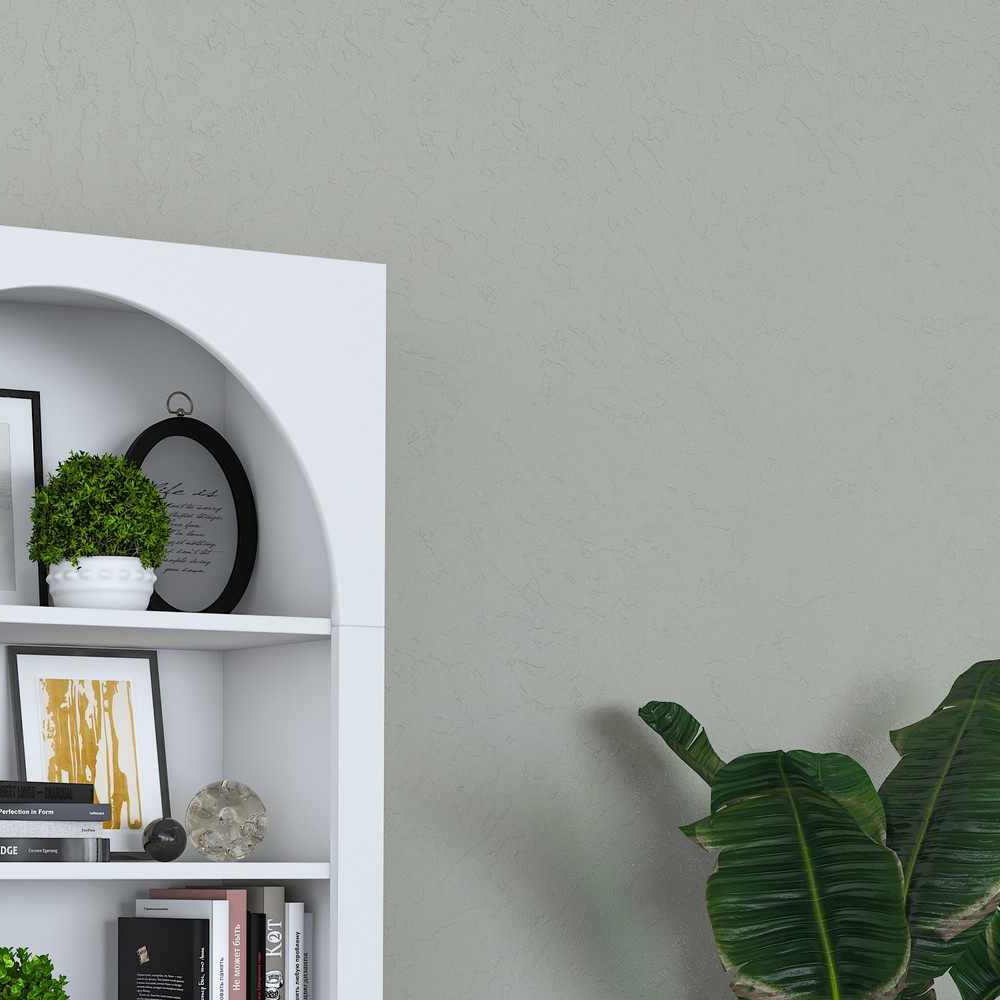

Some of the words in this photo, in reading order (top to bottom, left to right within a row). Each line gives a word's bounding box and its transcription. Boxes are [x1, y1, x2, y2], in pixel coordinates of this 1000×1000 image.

[232, 924, 241, 946] быть
[294, 932, 302, 962] проблему
[232, 948, 241, 978] может
[232, 980, 240, 991] Не
